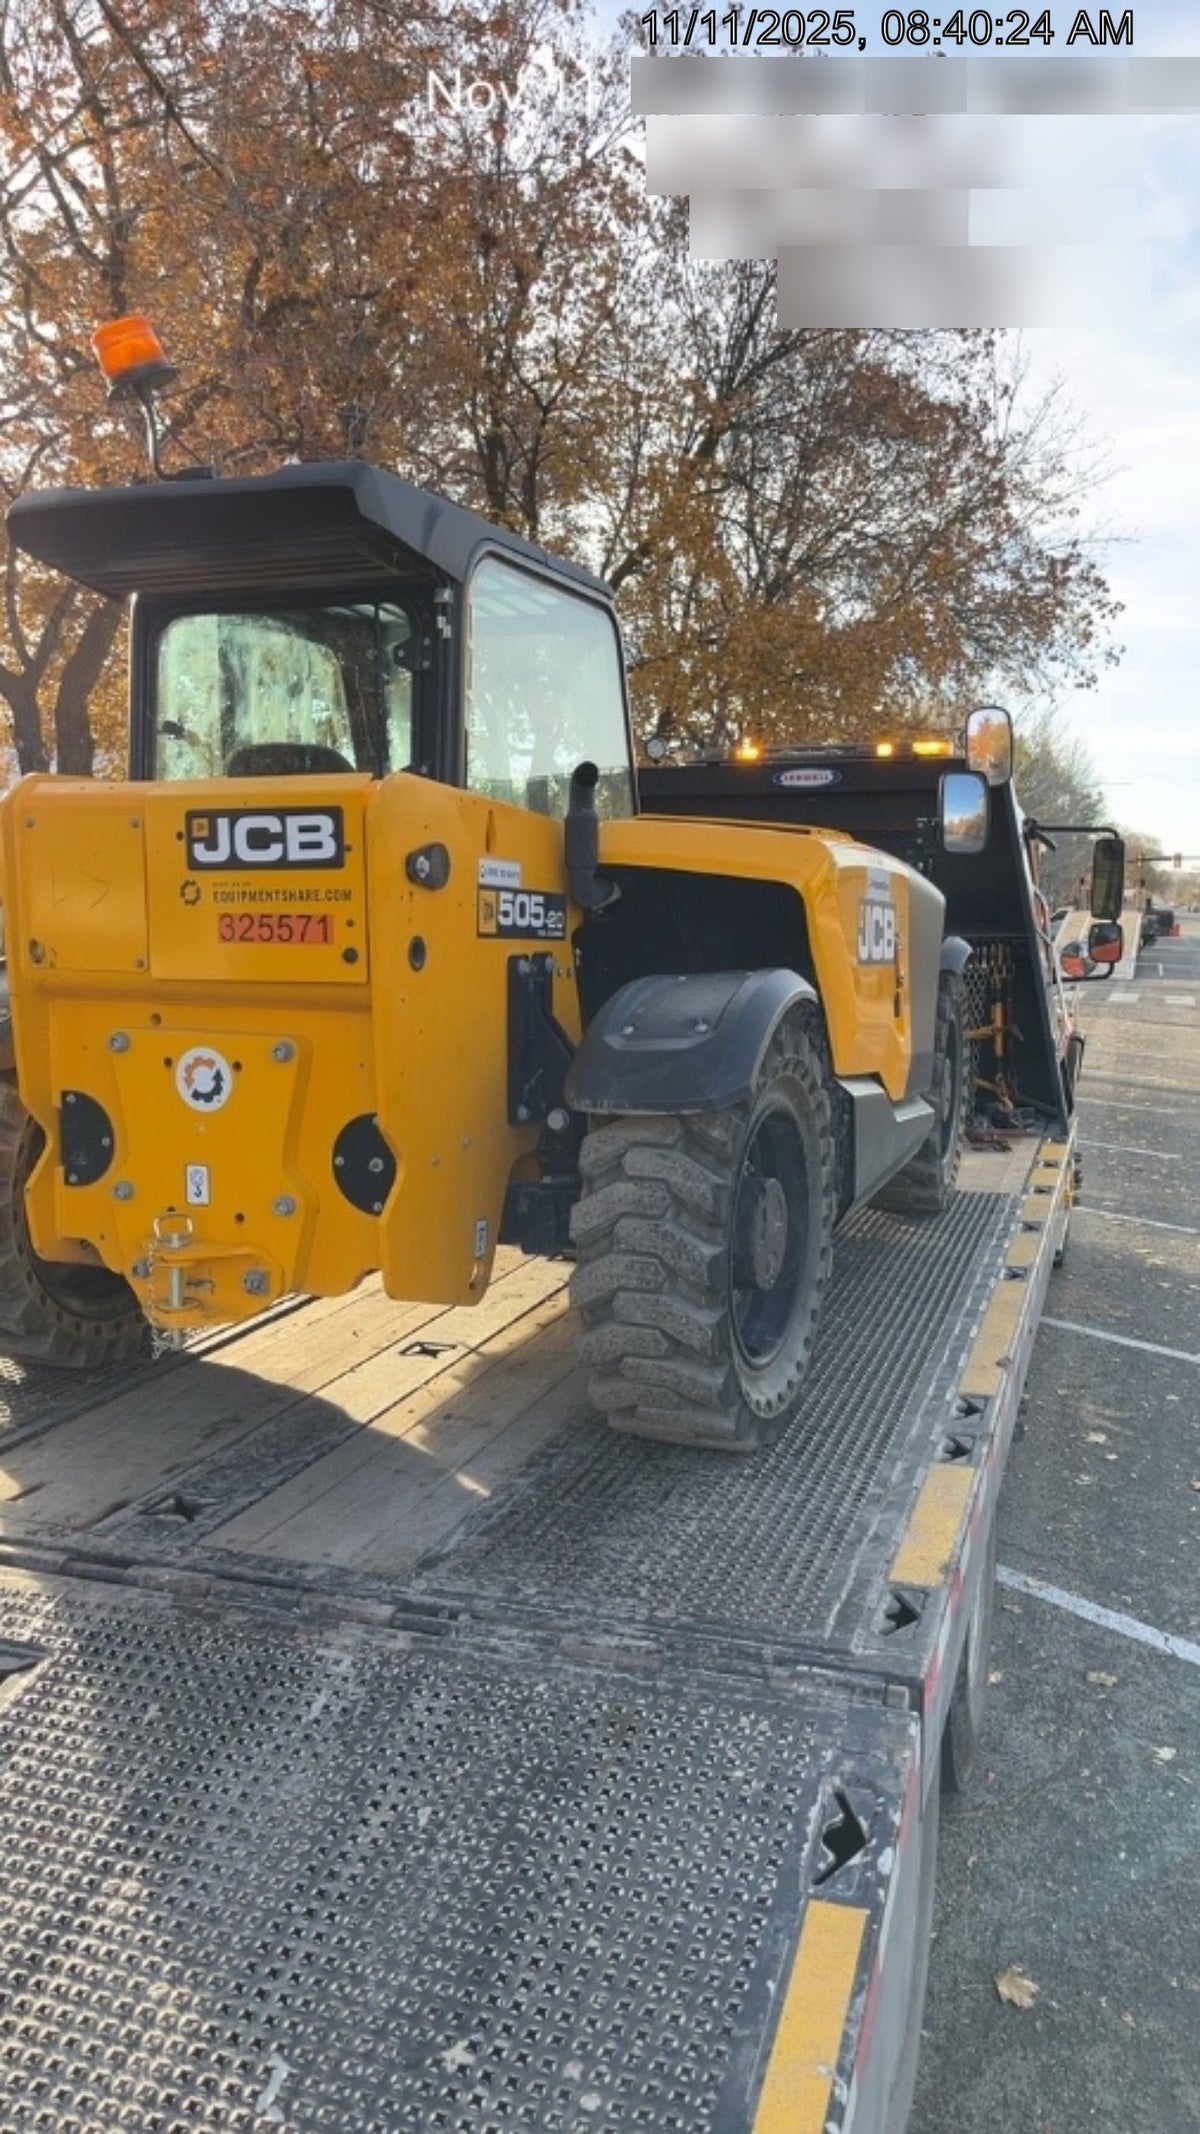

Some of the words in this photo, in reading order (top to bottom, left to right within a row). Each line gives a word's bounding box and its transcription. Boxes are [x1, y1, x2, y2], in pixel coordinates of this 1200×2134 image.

[193, 814, 338, 863] JCB
[212, 888, 352, 903] EQUIPMENTSHARE.COM
[219, 912, 330, 944] 325571
[857, 904, 896, 961] JCB
